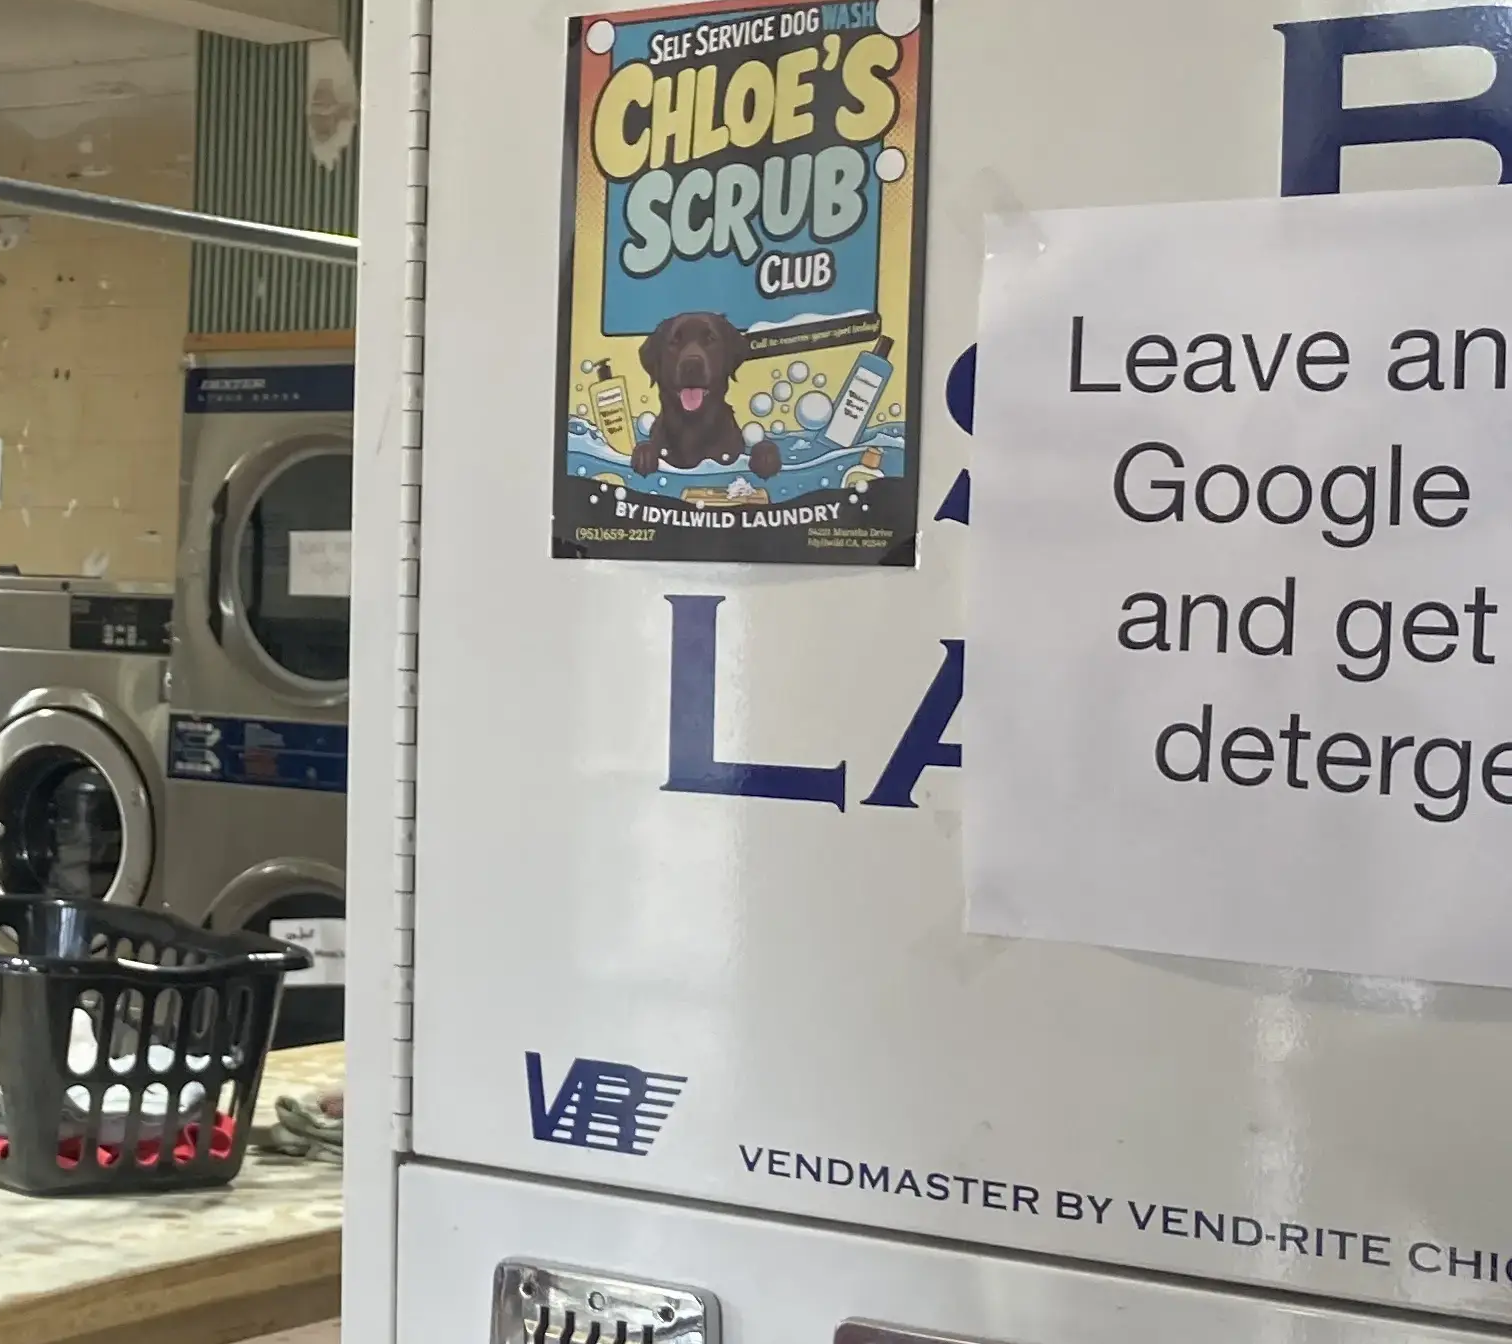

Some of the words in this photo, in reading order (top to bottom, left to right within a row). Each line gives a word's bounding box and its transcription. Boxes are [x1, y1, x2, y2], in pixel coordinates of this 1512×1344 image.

[650, 33, 691, 65] SELF
[695, 15, 775, 57] SERVICE
[780, 8, 820, 38] DOG
[821, 0, 877, 30] WASH
[595, 32, 899, 177] CHLOE'S
[623, 146, 865, 273] SCRUB
[759, 251, 832, 294] CLUB
[1070, 315, 1349, 394] Leave
[615, 501, 639, 518] BY
[642, 506, 735, 528] IDYLLWILD
[741, 503, 840, 528] LAUNDRY
[1113, 441, 1470, 548] Google
[1118, 576, 1296, 656] and
[1336, 587, 1498, 683] get
[739, 1145, 1039, 1215] VENDMASTER
[1056, 1190, 1113, 1224] BY
[1128, 1201, 1391, 1266] VEND-RITE
[1408, 1242, 1512, 1282] CHI
